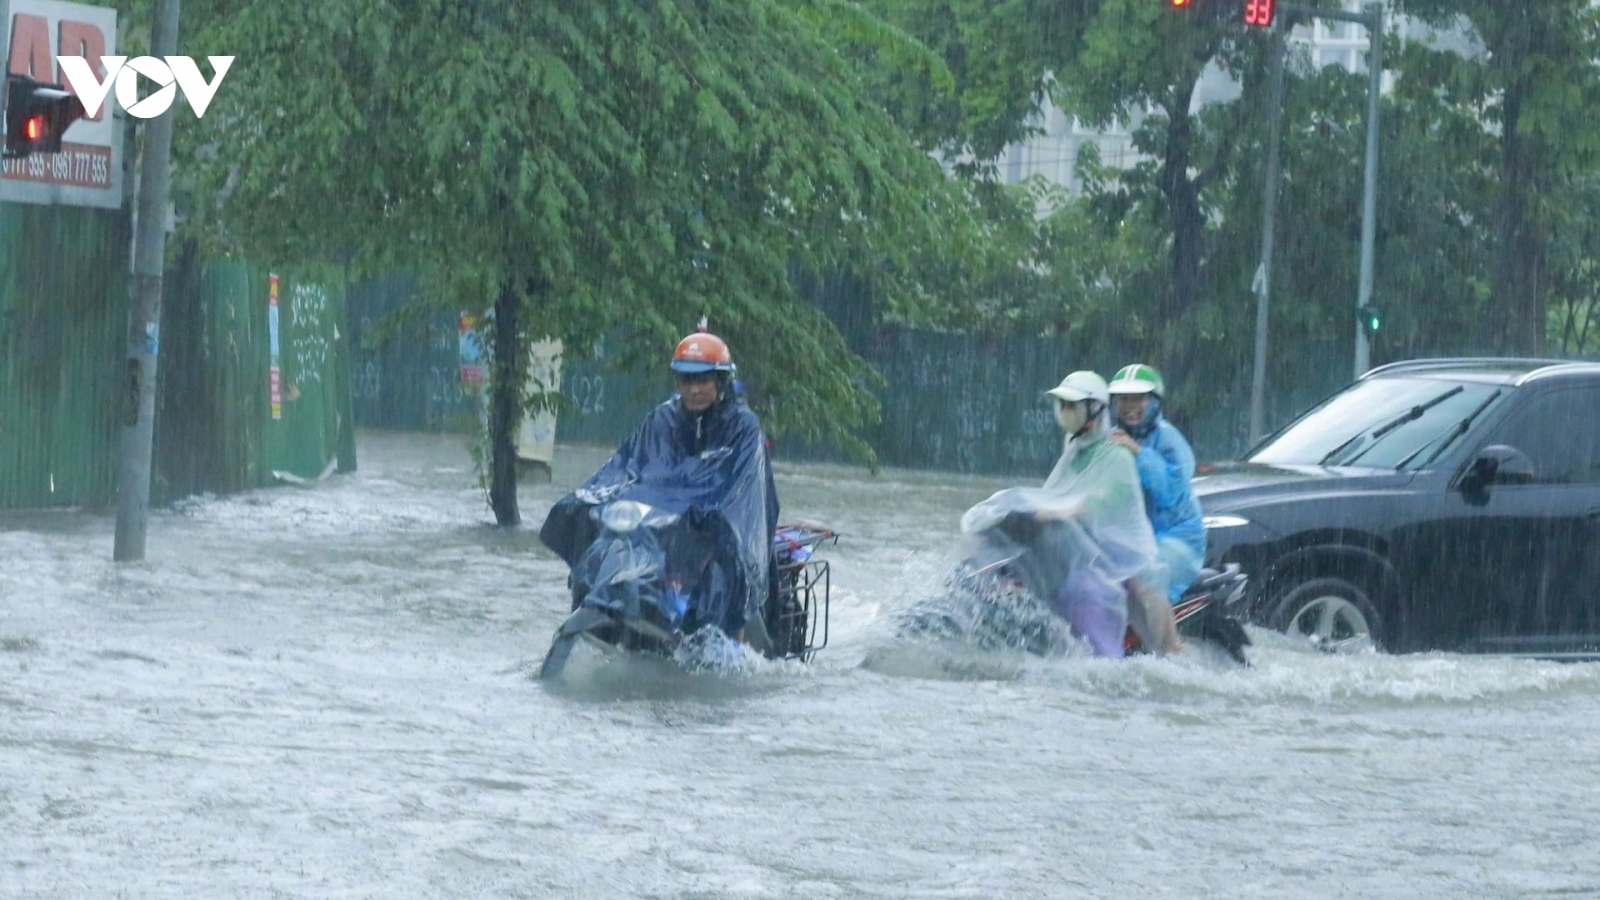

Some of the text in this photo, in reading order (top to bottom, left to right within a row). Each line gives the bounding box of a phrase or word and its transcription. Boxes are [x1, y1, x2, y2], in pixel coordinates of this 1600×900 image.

[1244, 0, 1271, 25] 33
[52, 150, 72, 180] 0961
[75, 153, 90, 182] 777
[91, 154, 107, 184] 555
